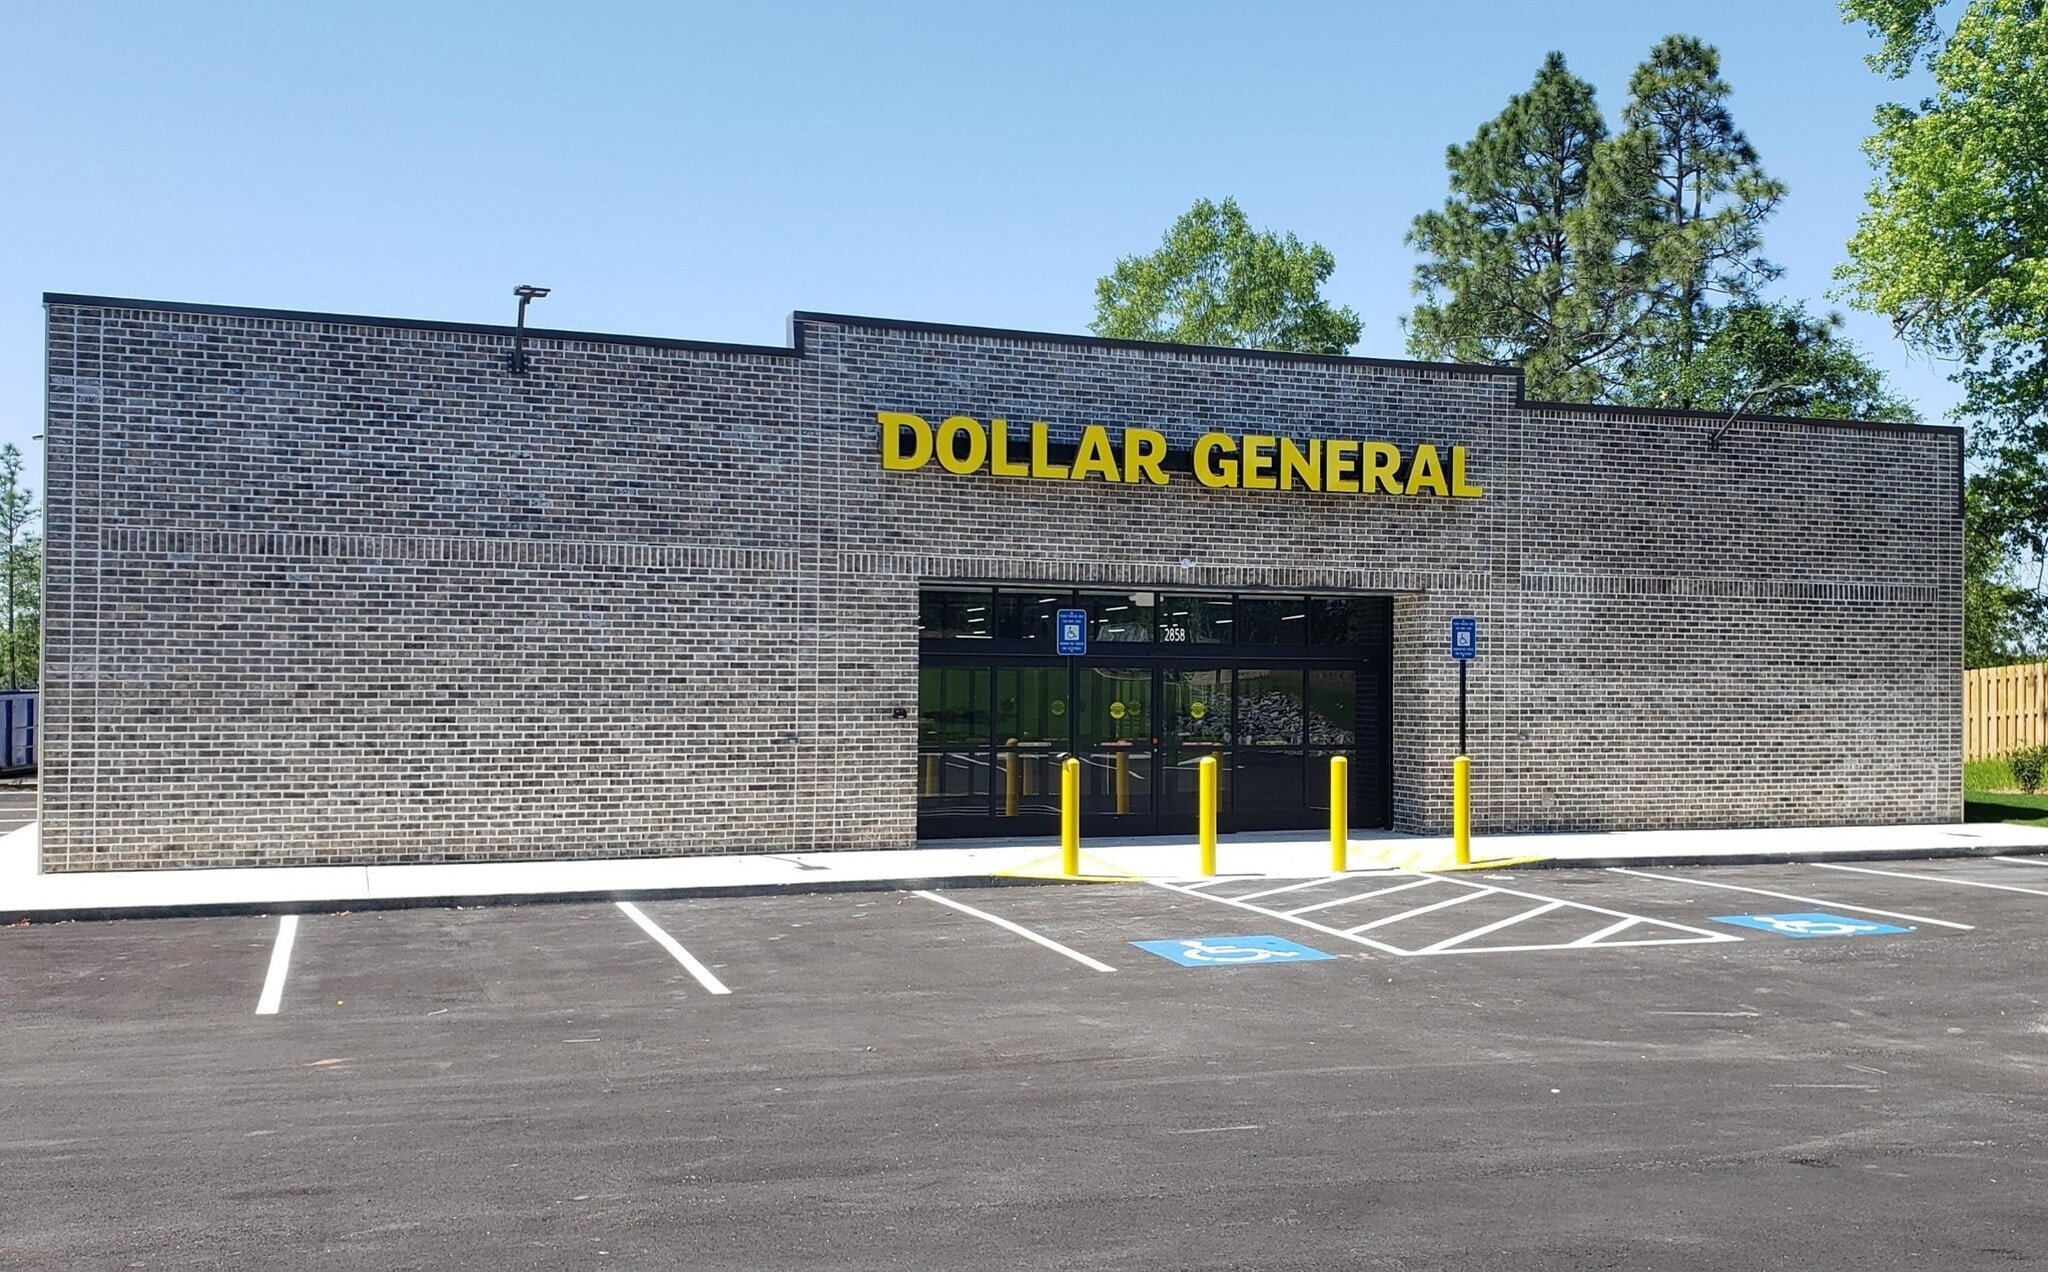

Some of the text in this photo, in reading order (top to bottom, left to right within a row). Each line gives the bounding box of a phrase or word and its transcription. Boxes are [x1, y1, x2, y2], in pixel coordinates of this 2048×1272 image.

[877, 412, 1484, 498] DOLLAR GENERAL
[1164, 627, 1186, 642] 2858
